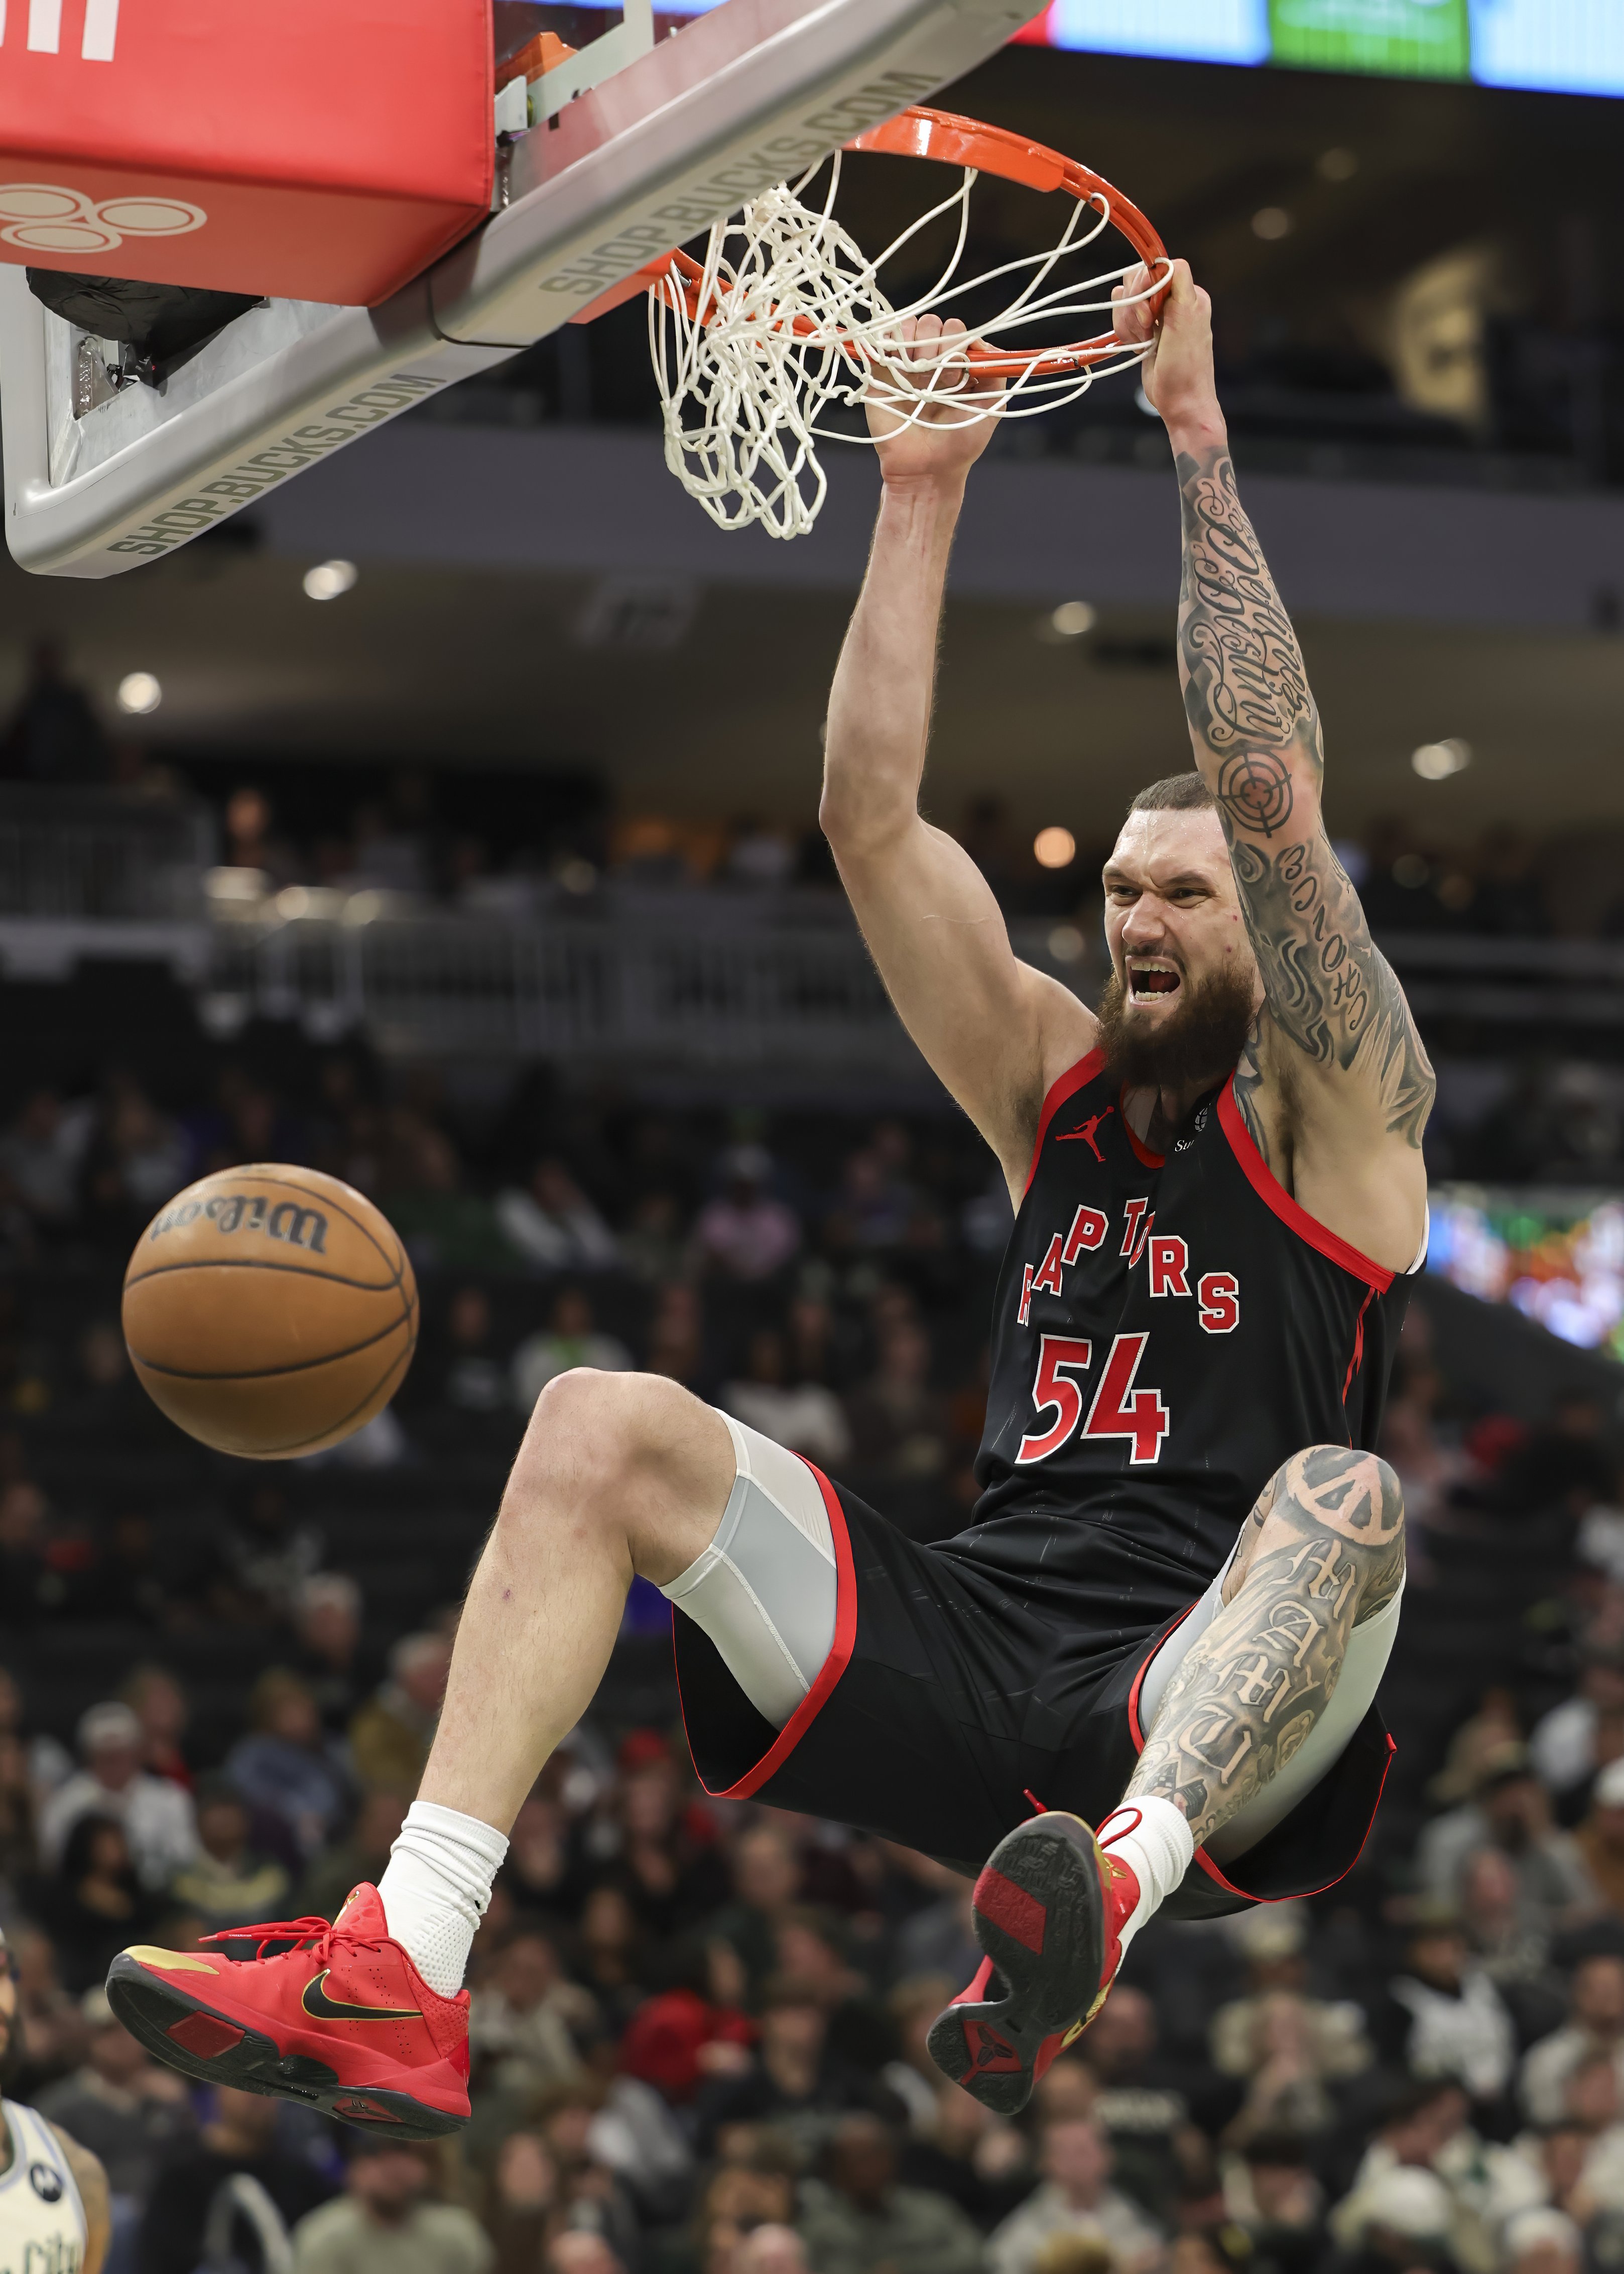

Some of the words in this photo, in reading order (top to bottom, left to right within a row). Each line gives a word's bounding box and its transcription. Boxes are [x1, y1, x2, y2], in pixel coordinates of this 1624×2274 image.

[539, 71, 942, 296] SHOP.BUCKS.COM
[106, 374, 447, 555] SHOP.BUCKS.COM
[1014, 1332, 1170, 1465] 54
